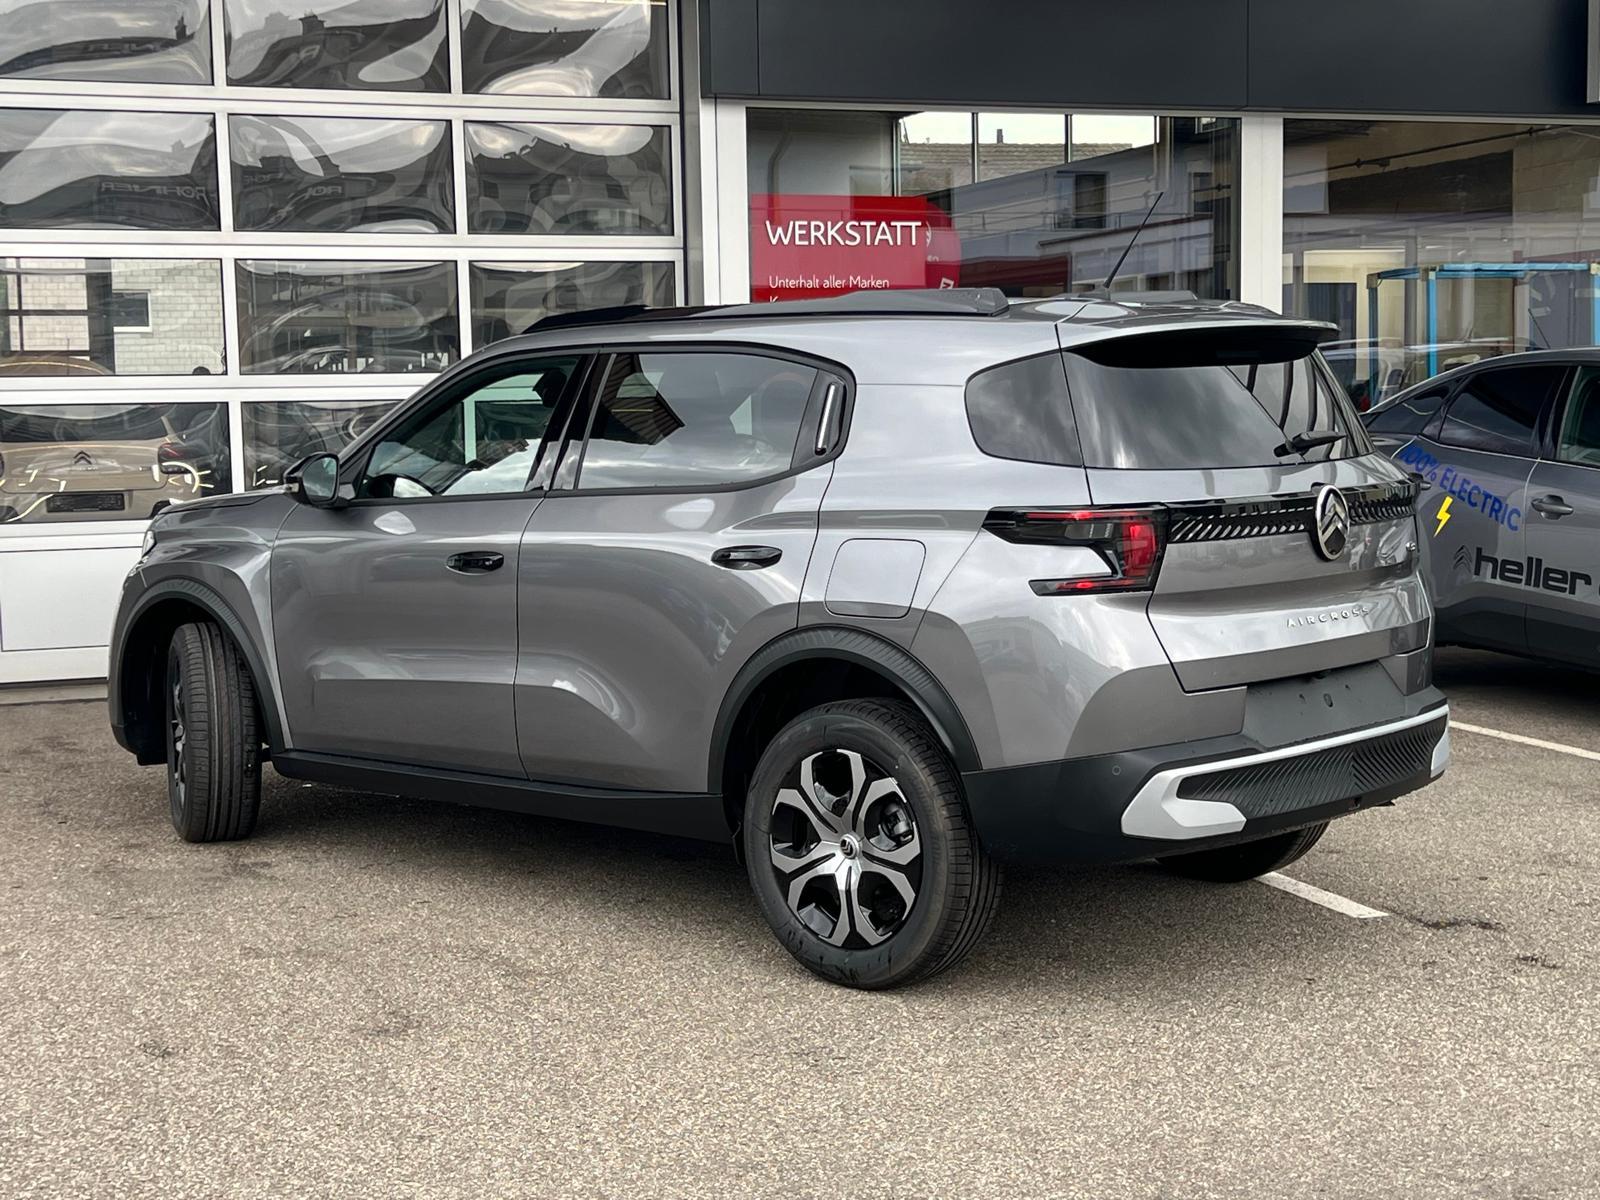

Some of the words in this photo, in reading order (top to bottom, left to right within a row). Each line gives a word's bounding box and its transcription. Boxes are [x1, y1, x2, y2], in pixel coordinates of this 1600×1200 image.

[765, 220, 922, 247] WERKSTATT
[769, 276, 819, 289] Unterhalt
[823, 276, 846, 289] aller
[849, 276, 890, 289] Marken
[1399, 444, 1440, 481] 100%
[1474, 547, 1592, 596] heller
[1286, 606, 1370, 628] AIRCROSS
